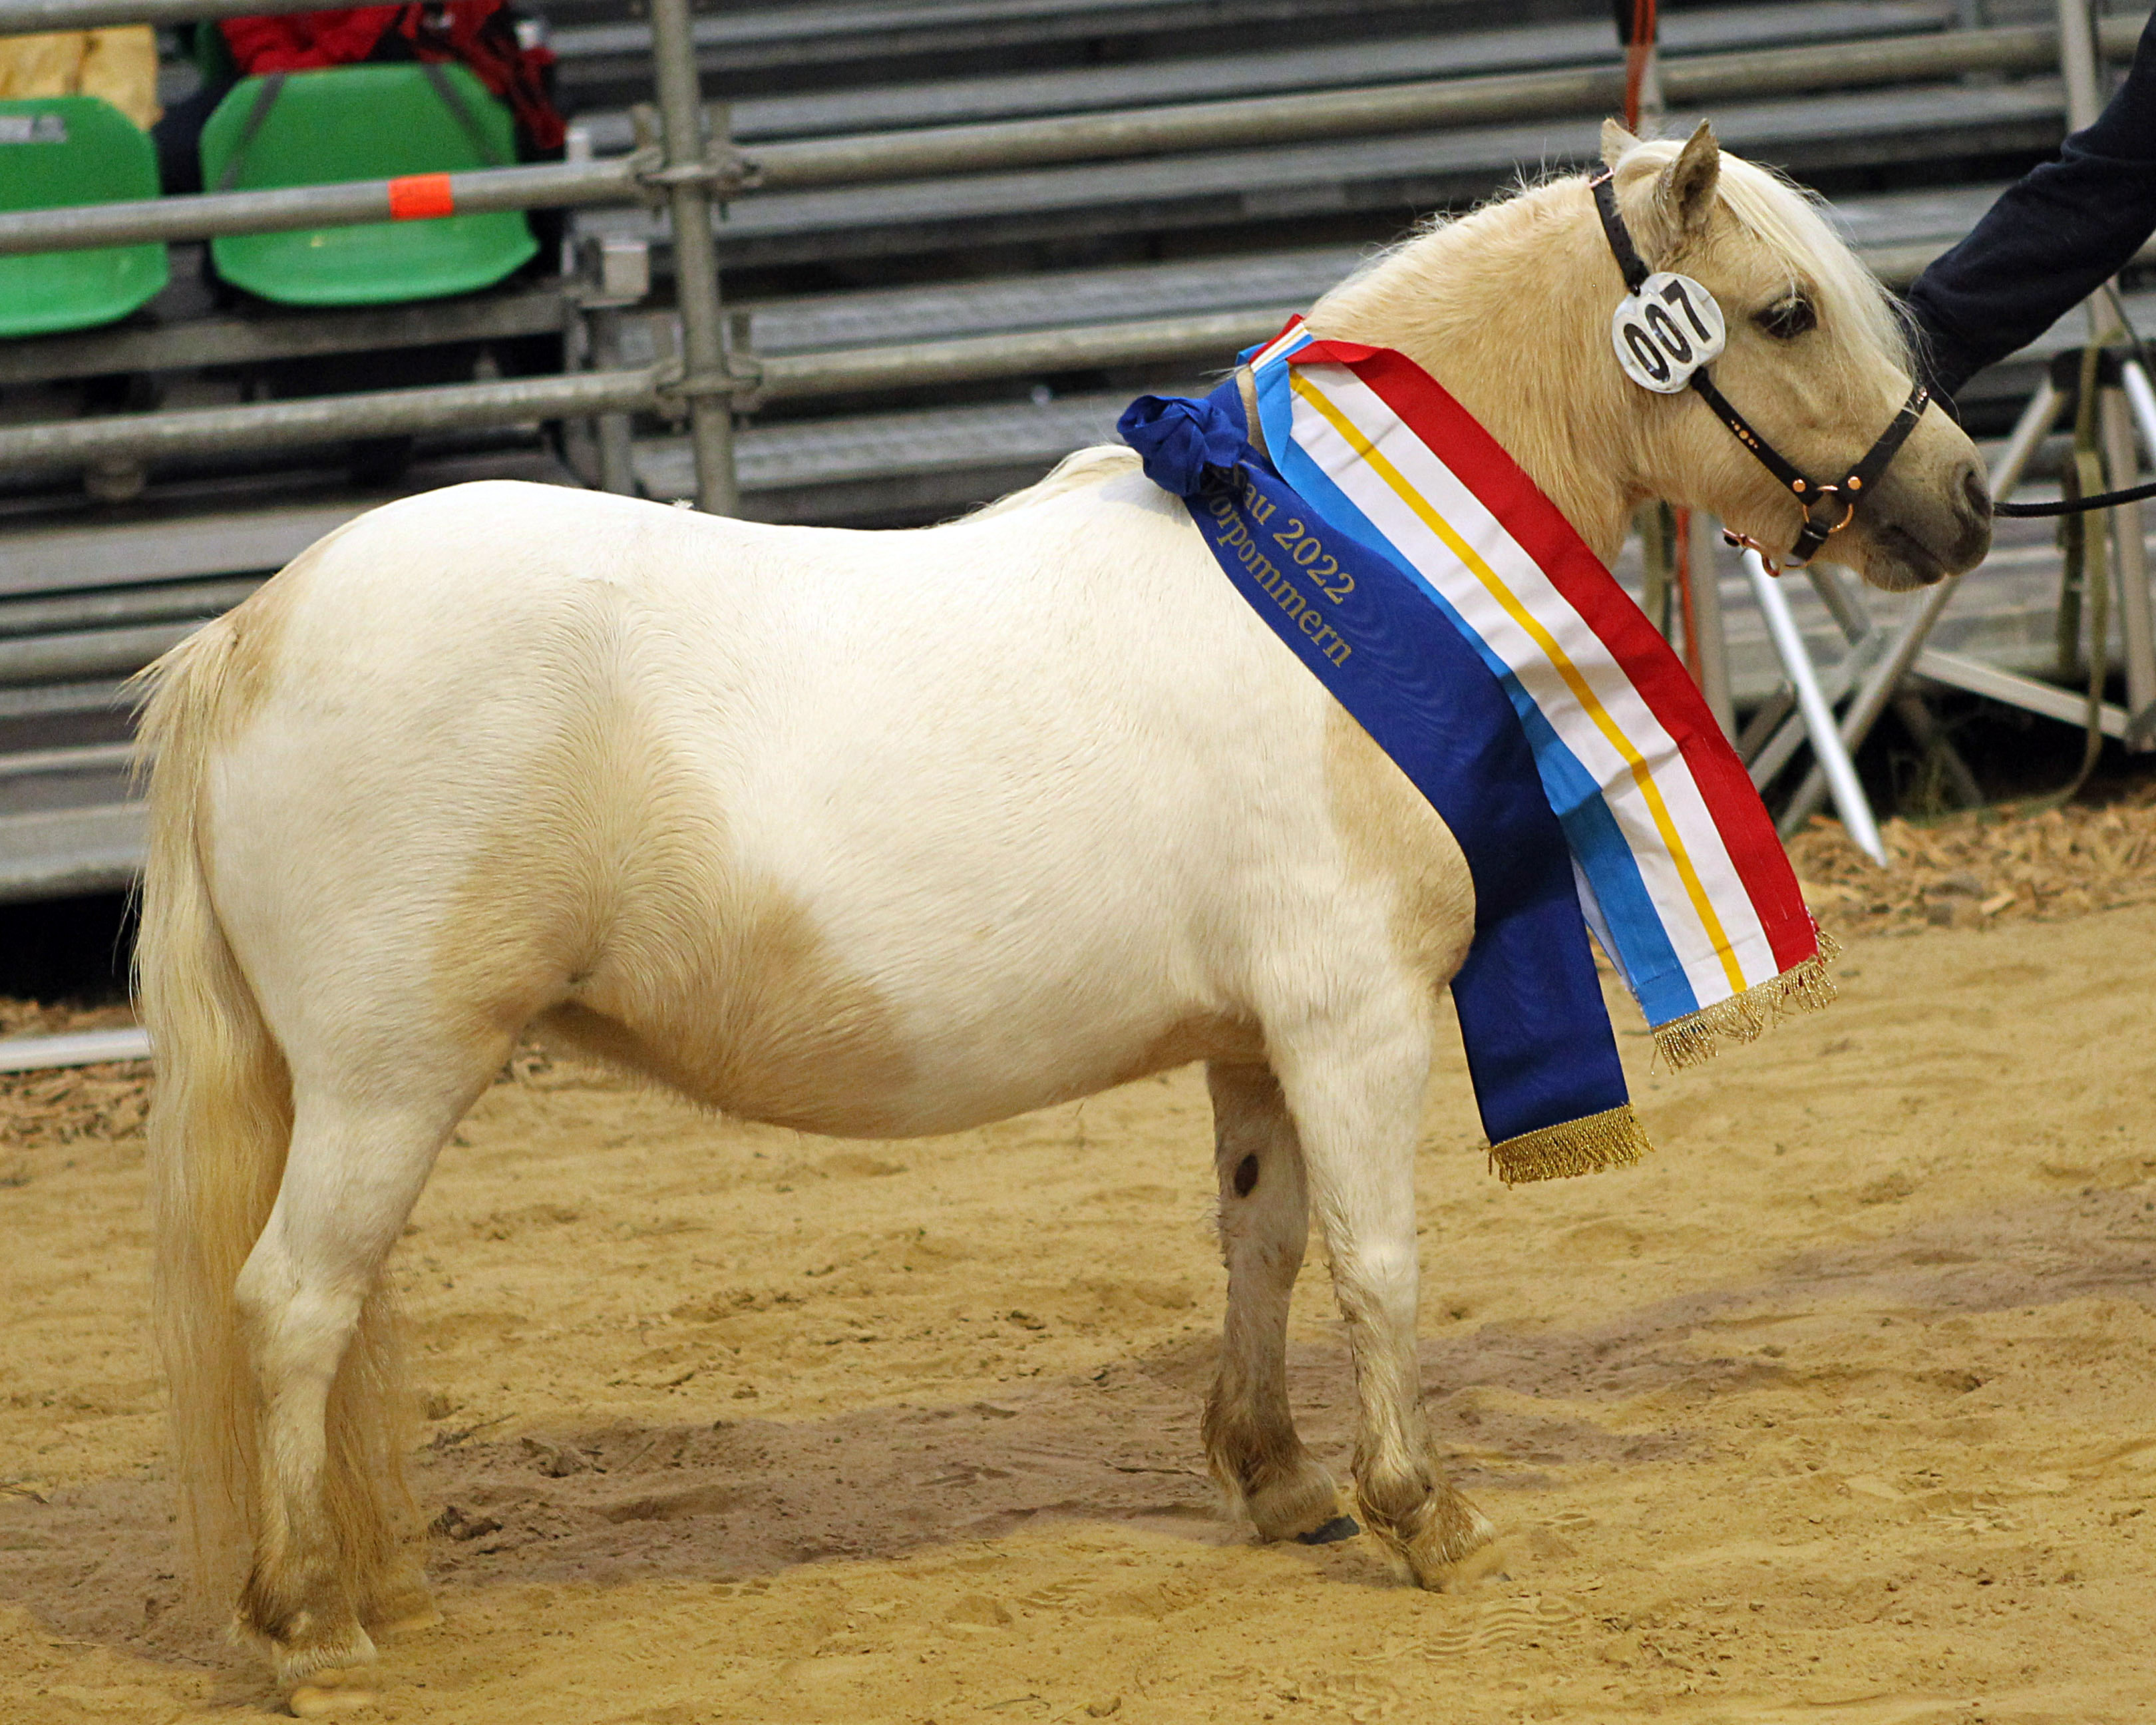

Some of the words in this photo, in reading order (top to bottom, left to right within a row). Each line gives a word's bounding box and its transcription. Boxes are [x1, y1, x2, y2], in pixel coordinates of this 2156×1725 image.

[1624, 280, 1711, 383] 007
[1208, 494, 1352, 668] orpommern
[1272, 518, 1355, 605] 2022
